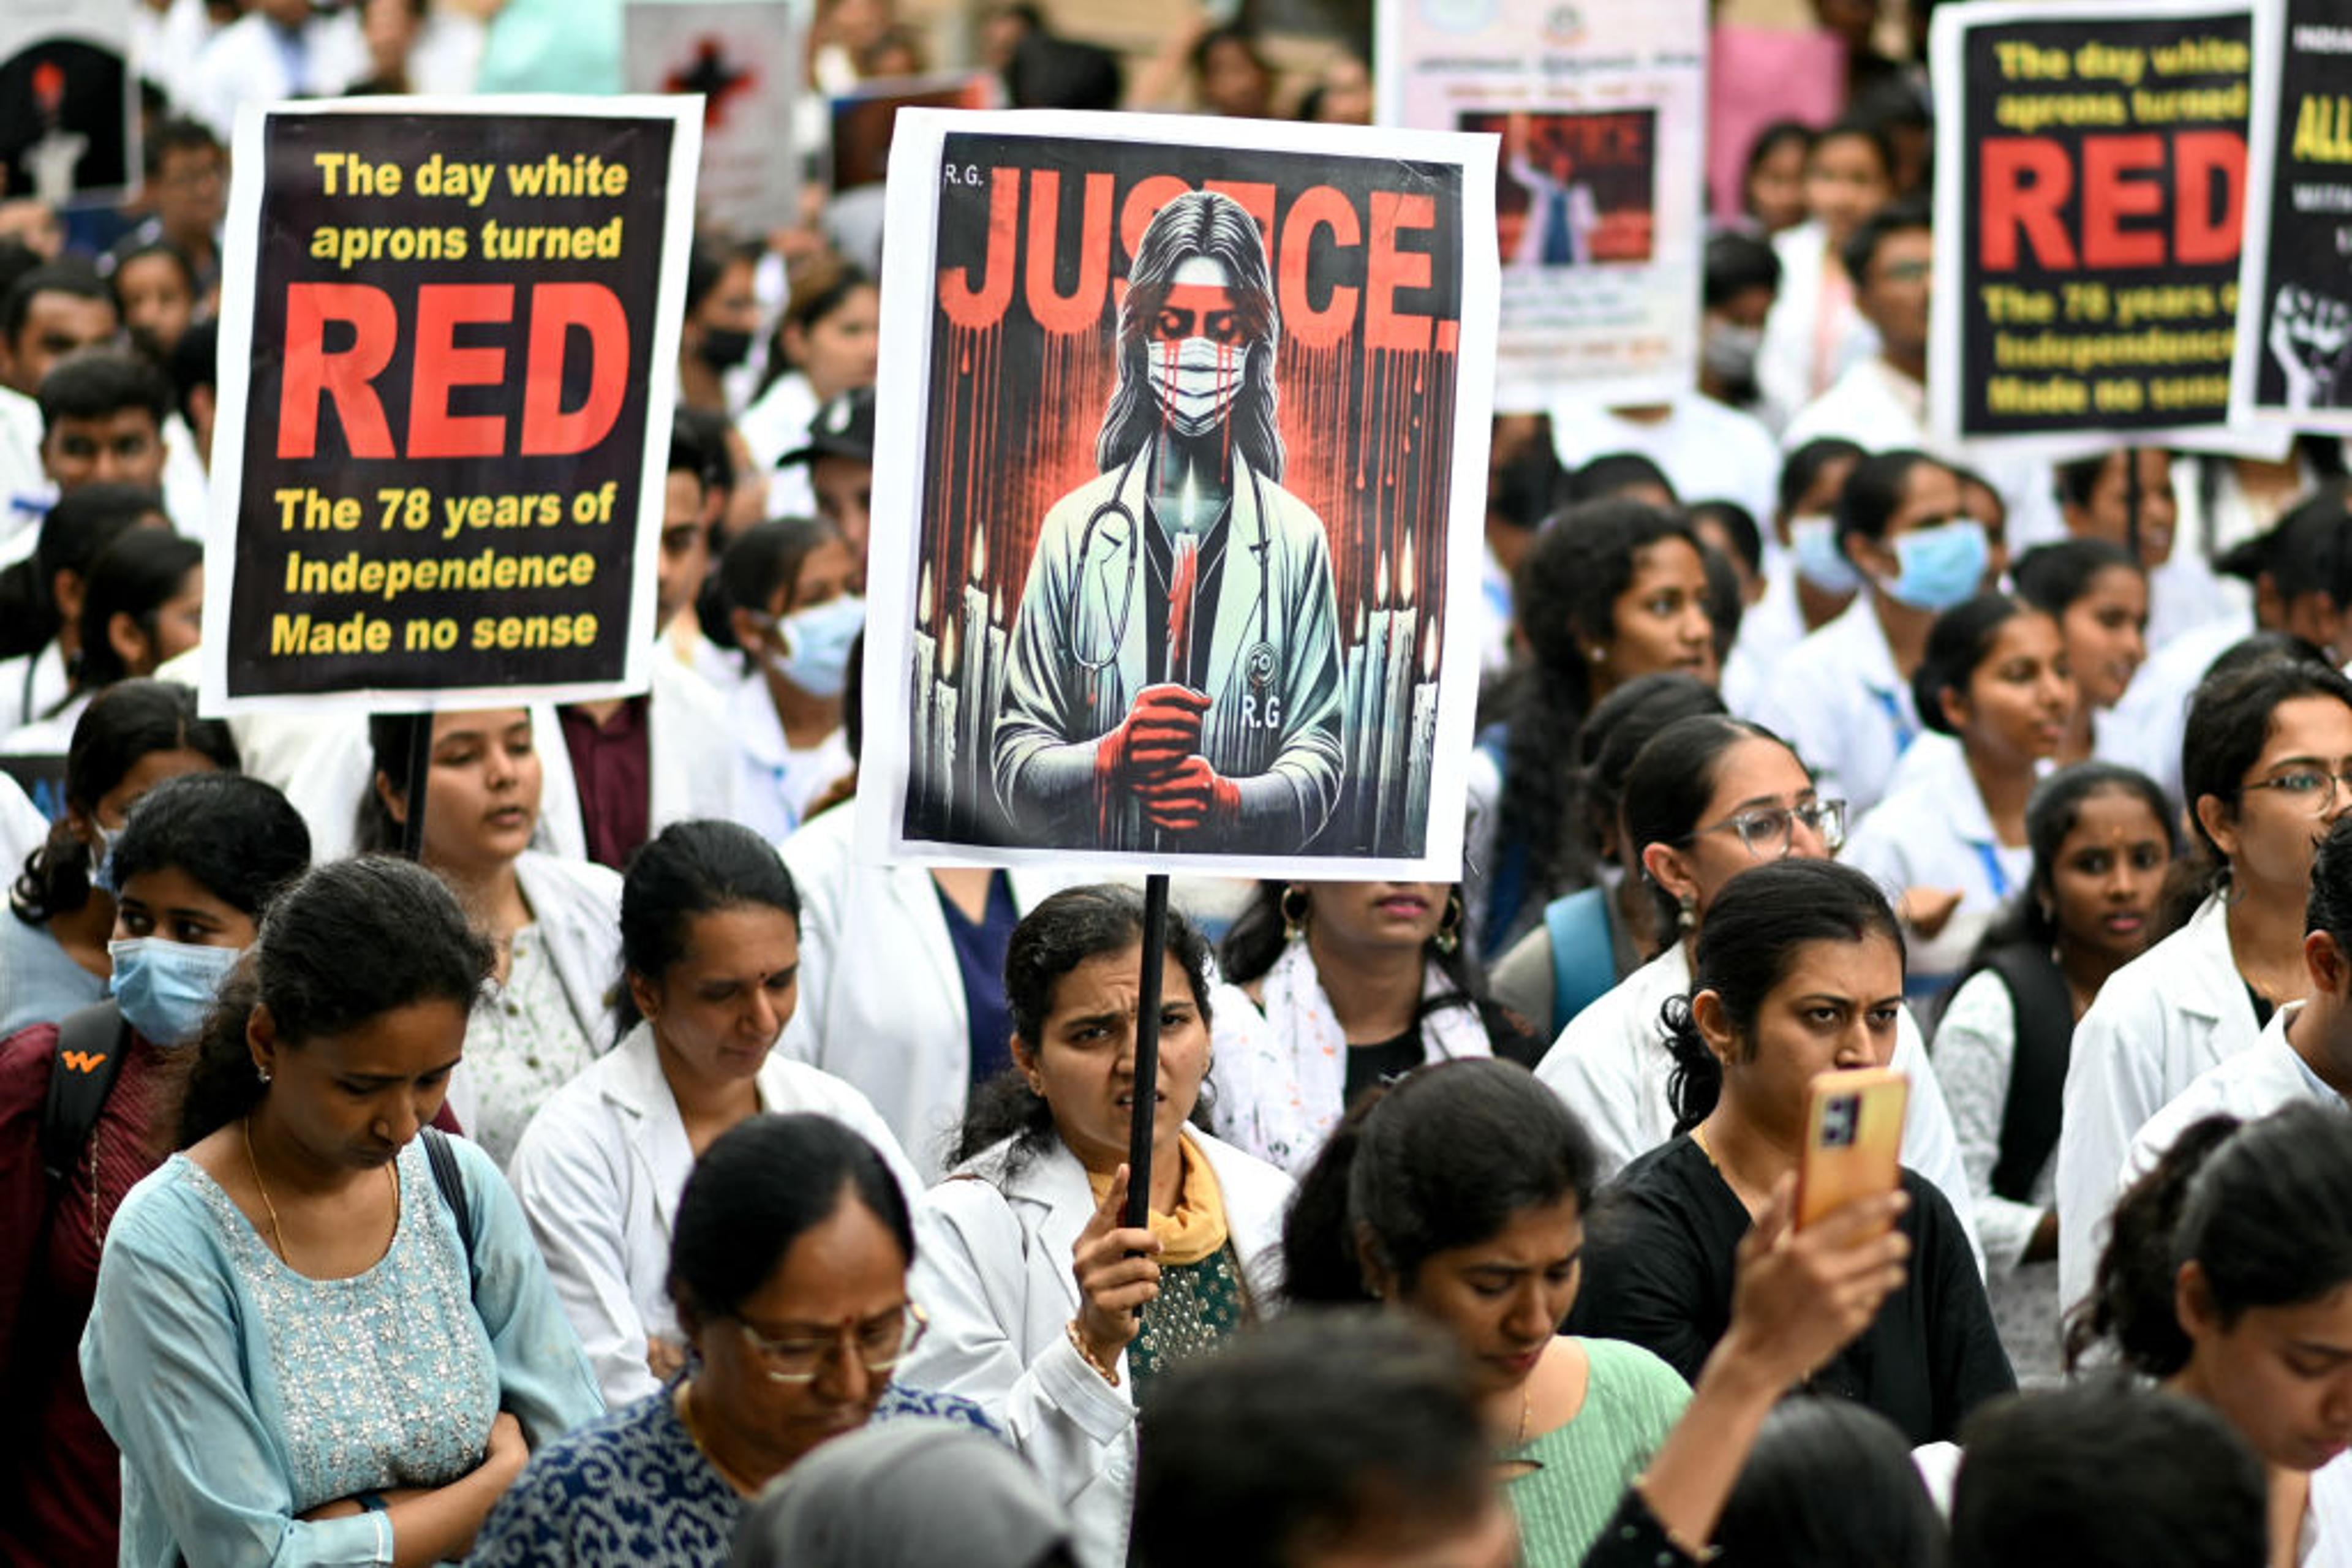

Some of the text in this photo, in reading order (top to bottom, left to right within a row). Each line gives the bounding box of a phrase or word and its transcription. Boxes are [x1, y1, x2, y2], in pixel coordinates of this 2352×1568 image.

[1994, 36, 2249, 86] The day white
[1996, 80, 2248, 134] aprons turned
[314, 153, 628, 206] The day white
[1981, 129, 2250, 270] RED
[311, 217, 623, 268] aprons turned
[1980, 282, 2239, 326] The 78 years o
[277, 282, 630, 459] RED
[1987, 375, 2228, 415] Made no sens
[274, 481, 617, 540] The 78 years of
[285, 549, 595, 600] Independence
[271, 612, 598, 655] Made no sense
